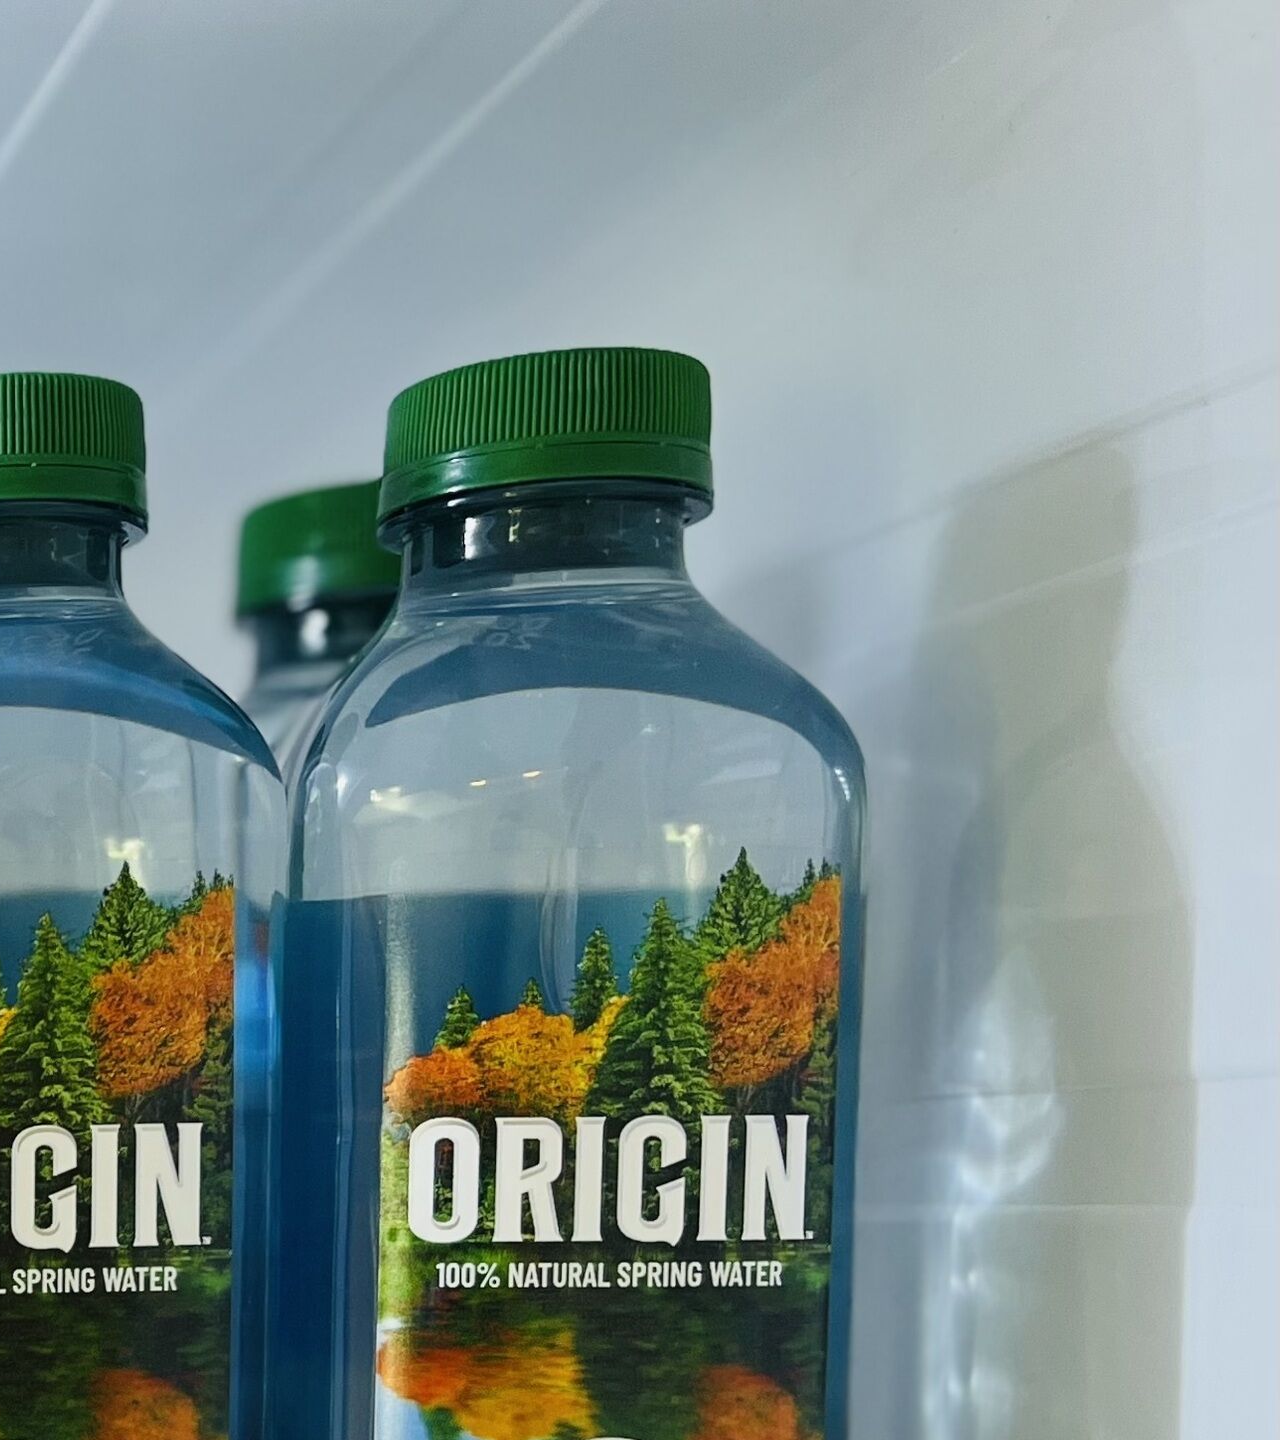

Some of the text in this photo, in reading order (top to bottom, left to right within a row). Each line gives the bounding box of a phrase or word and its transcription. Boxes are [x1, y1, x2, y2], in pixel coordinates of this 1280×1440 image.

[408, 1114, 809, 1247] ORIGIN
[12, 1267, 96, 1295] SPRING
[102, 1266, 178, 1292] WATER
[435, 1260, 783, 1290] 100% NATURAL SPRING WATER
